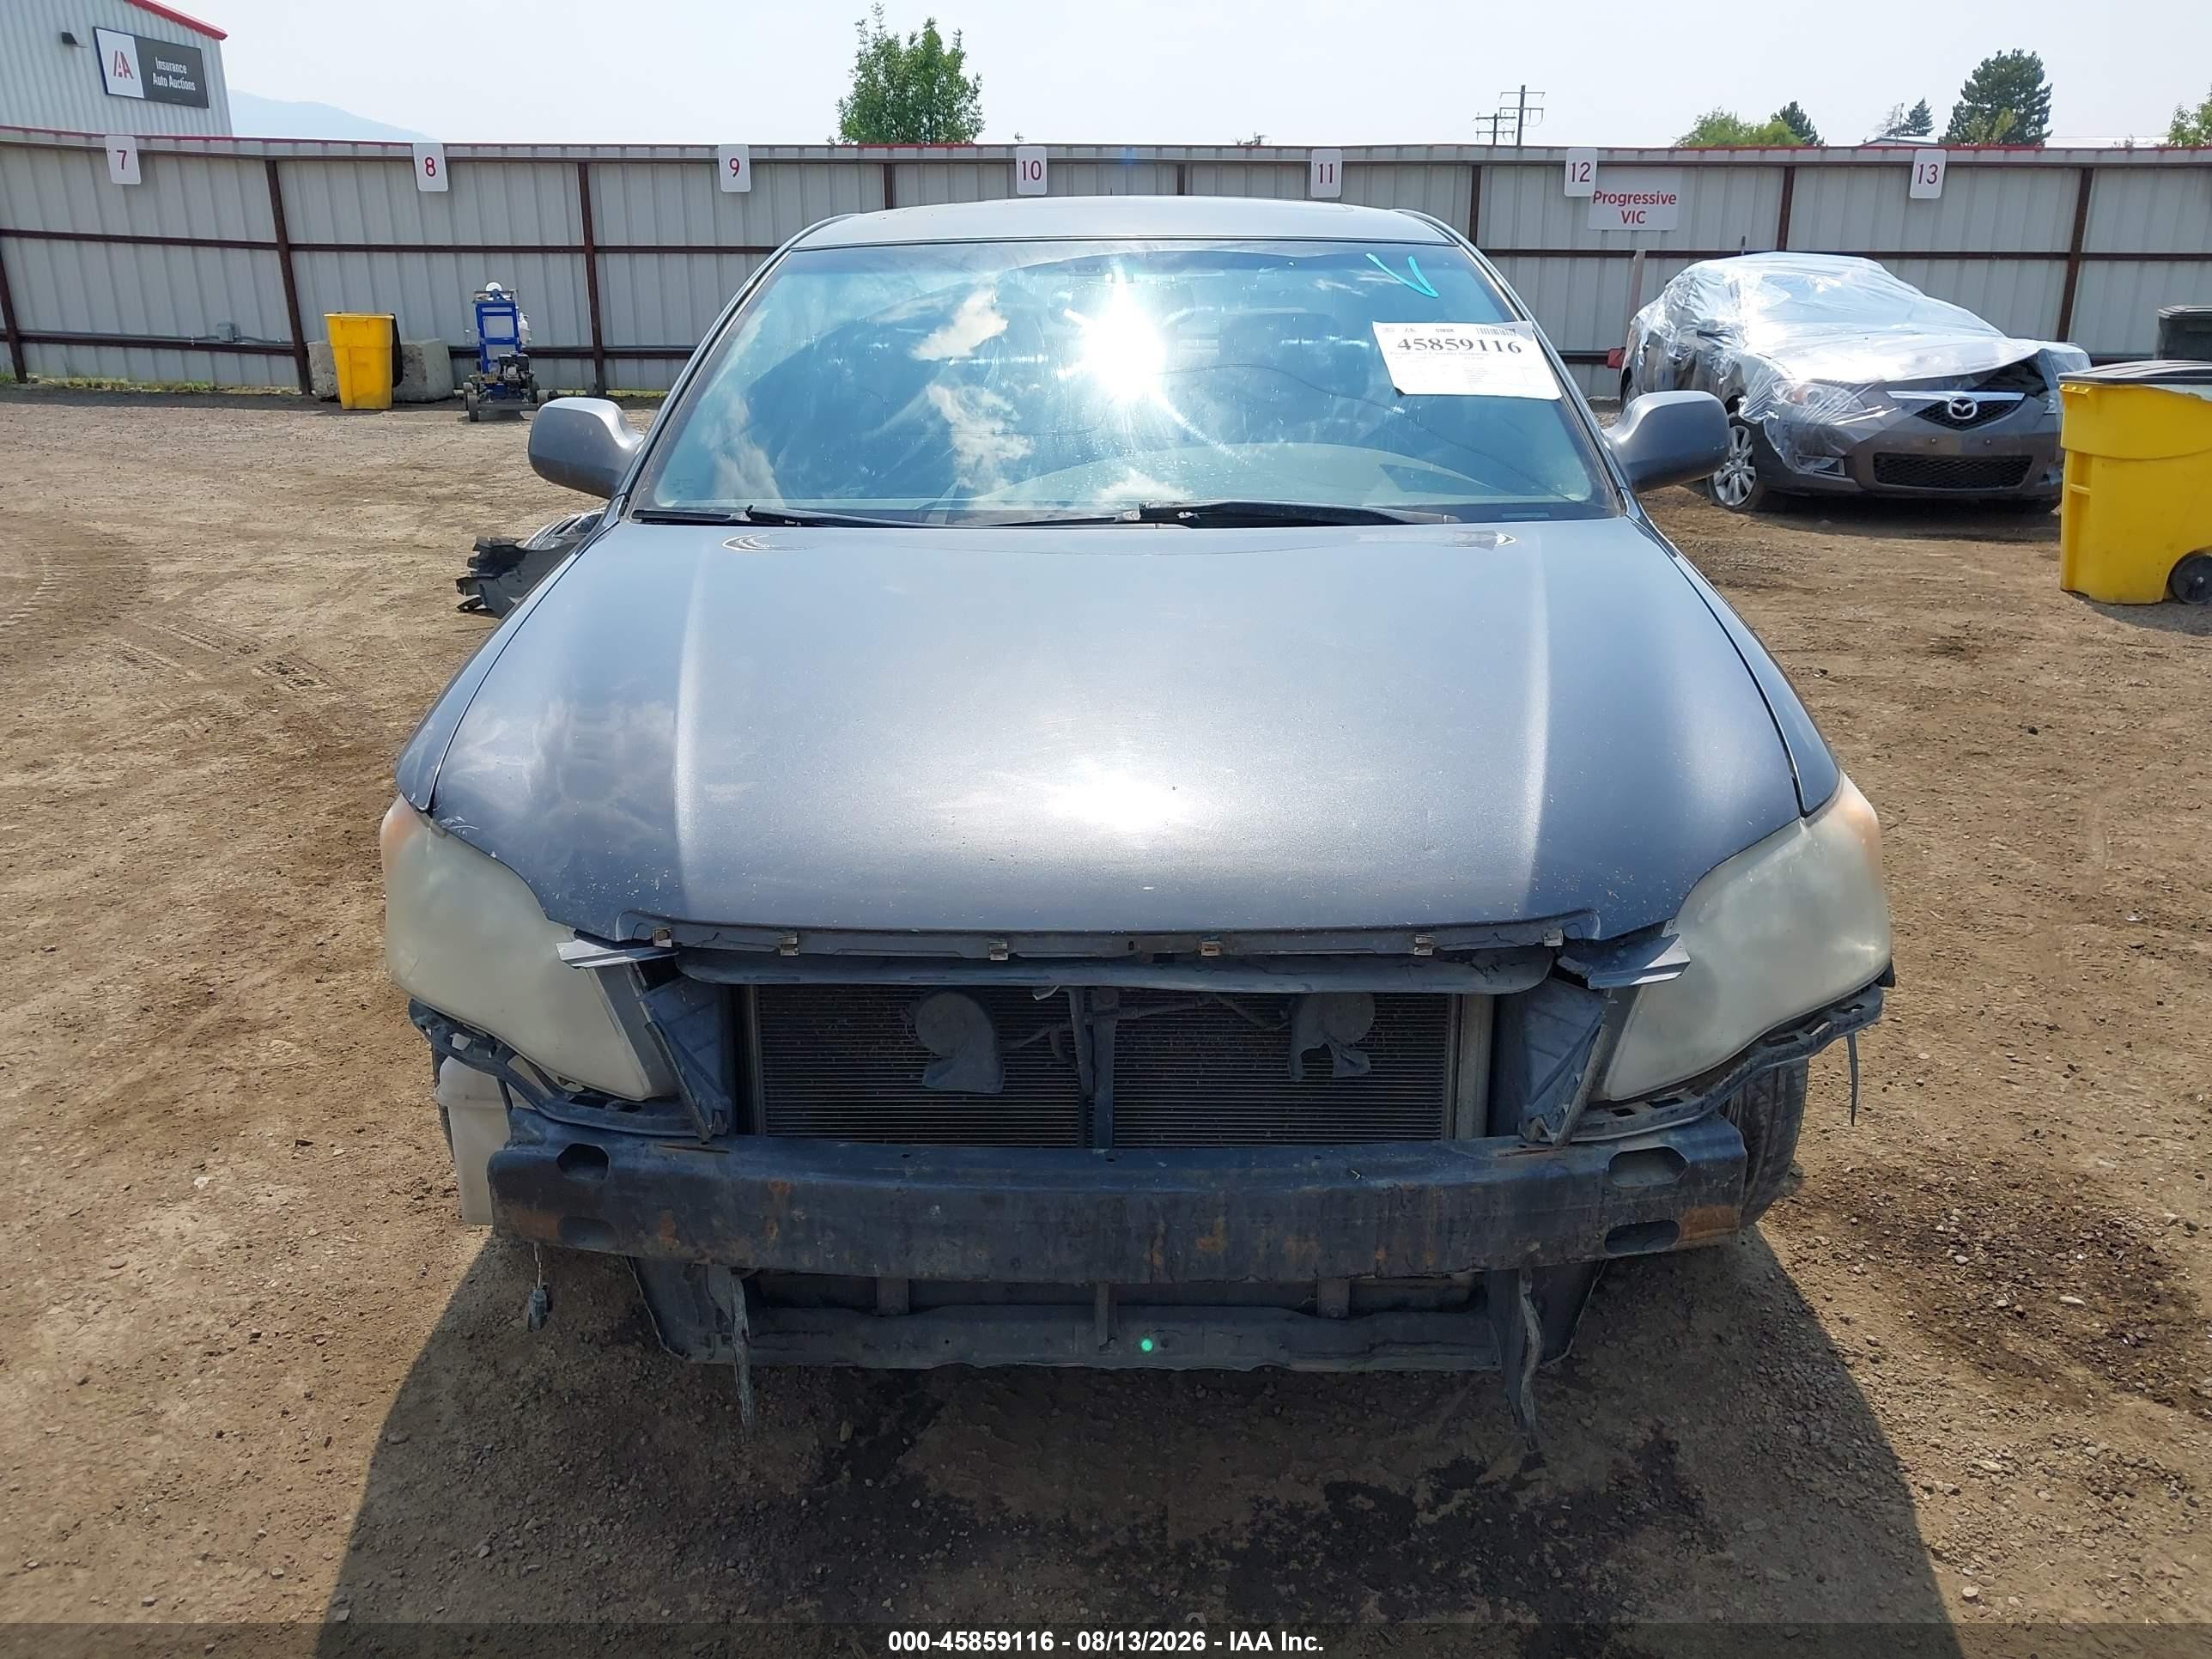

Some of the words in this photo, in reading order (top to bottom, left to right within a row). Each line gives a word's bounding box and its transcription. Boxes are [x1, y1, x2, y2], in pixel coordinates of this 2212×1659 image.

[155, 56, 187, 74] Insurance
[152, 72, 168, 88] Auto
[168, 75, 196, 91] Auctions
[116, 149, 128, 170] 7
[424, 156, 436, 177] 8
[729, 157, 740, 178] 9
[1021, 160, 1042, 181] 10
[1318, 162, 1334, 184] 11
[1570, 161, 1591, 183] 12
[1917, 163, 1939, 185] 13
[1592, 190, 1677, 207] Progressive
[1620, 210, 1646, 224] VIC
[1396, 337, 1522, 355] 45859116
